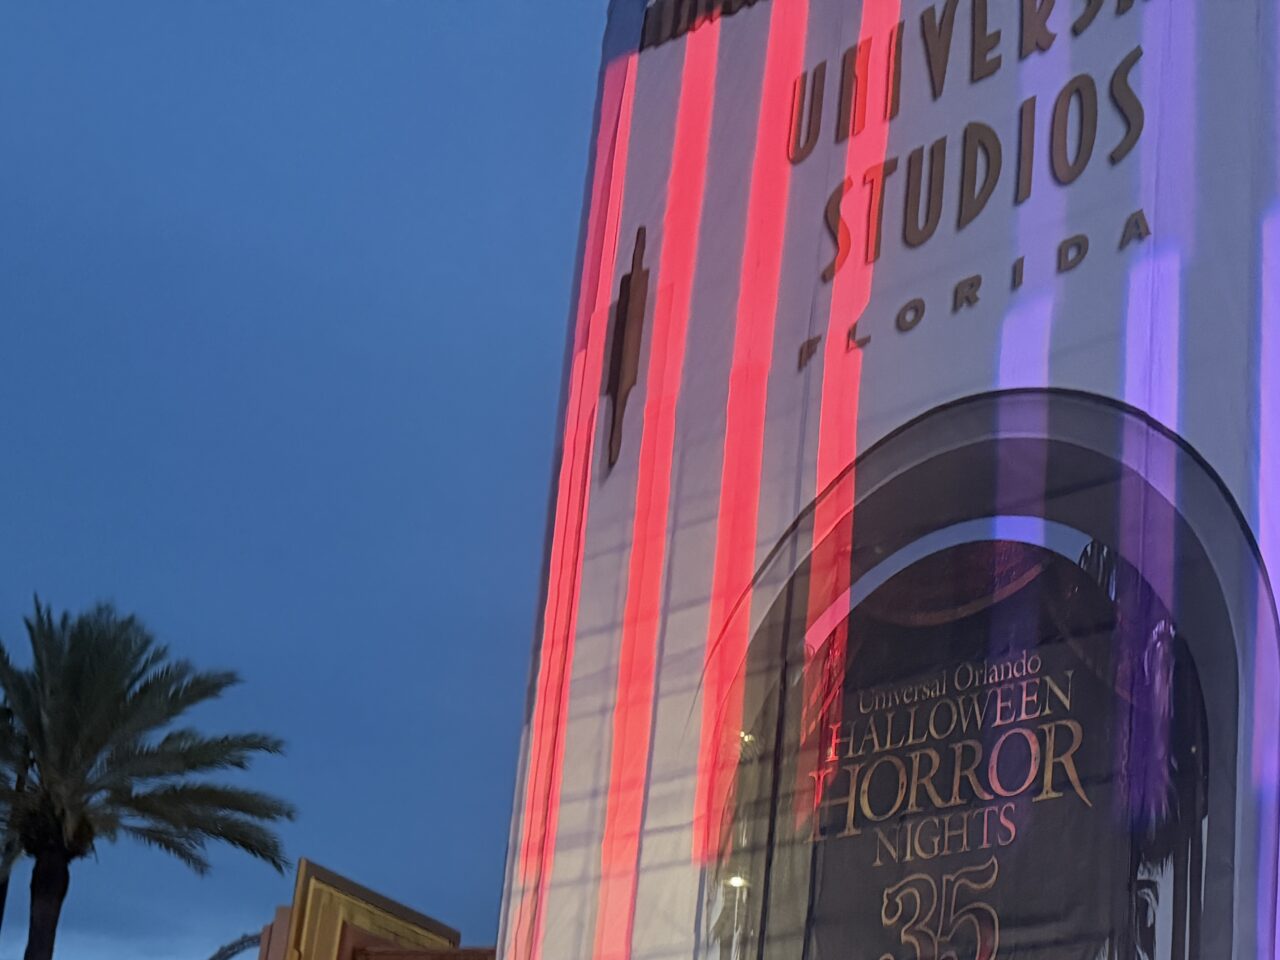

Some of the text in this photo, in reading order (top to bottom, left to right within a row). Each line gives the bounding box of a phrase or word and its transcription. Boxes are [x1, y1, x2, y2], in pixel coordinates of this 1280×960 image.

[787, 0, 1148, 165] UNIVER
[821, 45, 1145, 284] STUDIOS
[798, 209, 1152, 371] FLORIDA
[825, 670, 1074, 762] HALLOWEEN
[858, 650, 1042, 715] Universal Orlando
[804, 718, 1093, 844] HORROR
[872, 801, 1017, 867] NIGHTS
